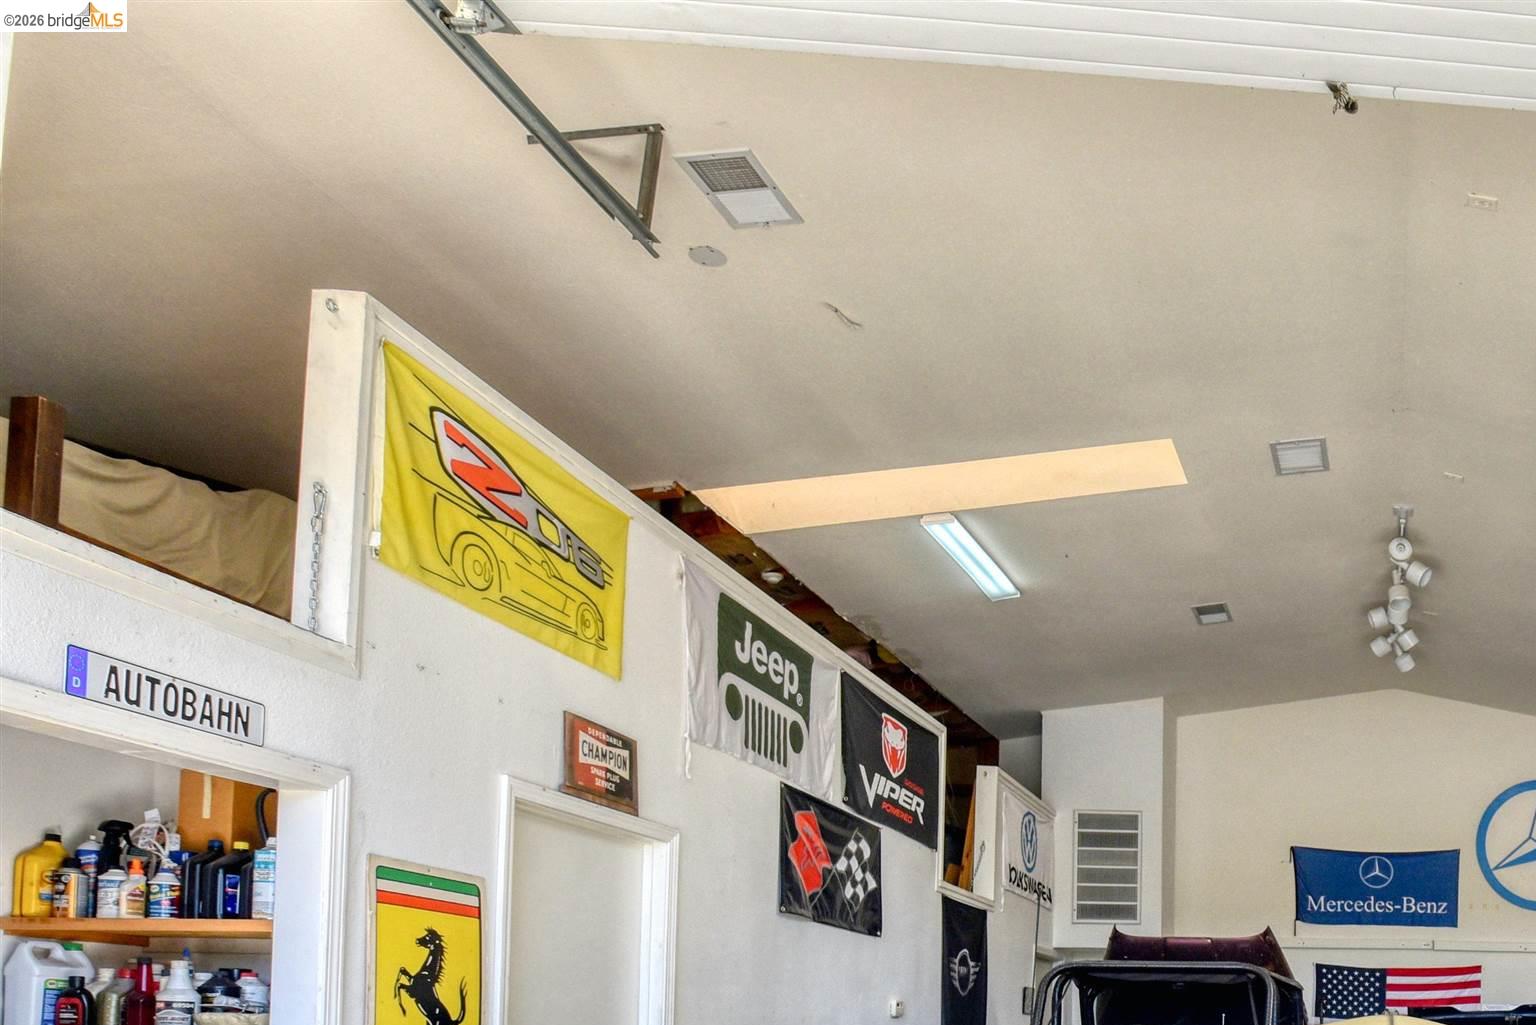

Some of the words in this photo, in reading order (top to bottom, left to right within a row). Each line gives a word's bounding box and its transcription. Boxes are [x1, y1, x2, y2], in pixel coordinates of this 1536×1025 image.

[72, 676, 81, 688] D
[104, 665, 250, 737] AUTOBAHN
[581, 740, 628, 772] CHAMPION
[595, 777, 616, 792] SERVICE
[859, 763, 925, 825] VIPER
[1307, 895, 1447, 914] Mercedes-Benz
